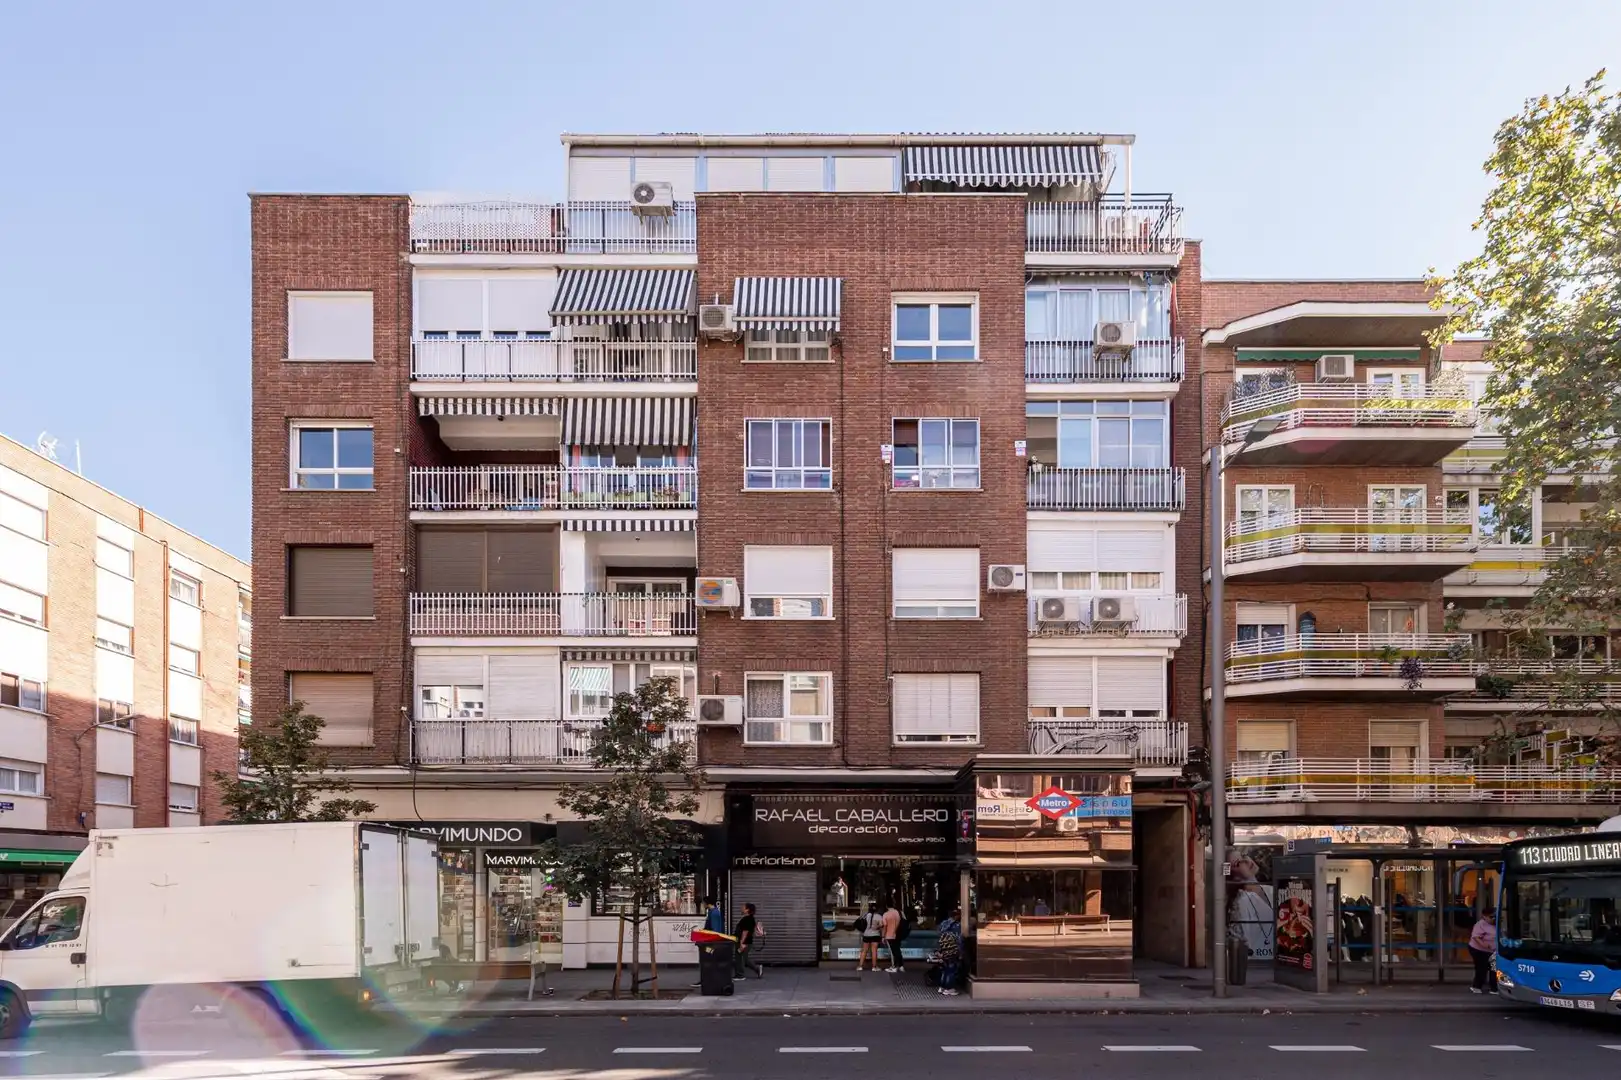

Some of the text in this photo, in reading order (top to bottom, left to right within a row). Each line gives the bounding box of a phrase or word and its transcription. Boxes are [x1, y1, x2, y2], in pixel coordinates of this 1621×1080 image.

[1040, 799, 1068, 807] Metro
[755, 808, 830, 822] RAFAEL
[835, 808, 949, 822] CABALLERO
[808, 823, 898, 834] decoración
[1520, 842, 1621, 864] 113 CIUDAD LINEA
[1517, 964, 1535, 974] 5710
